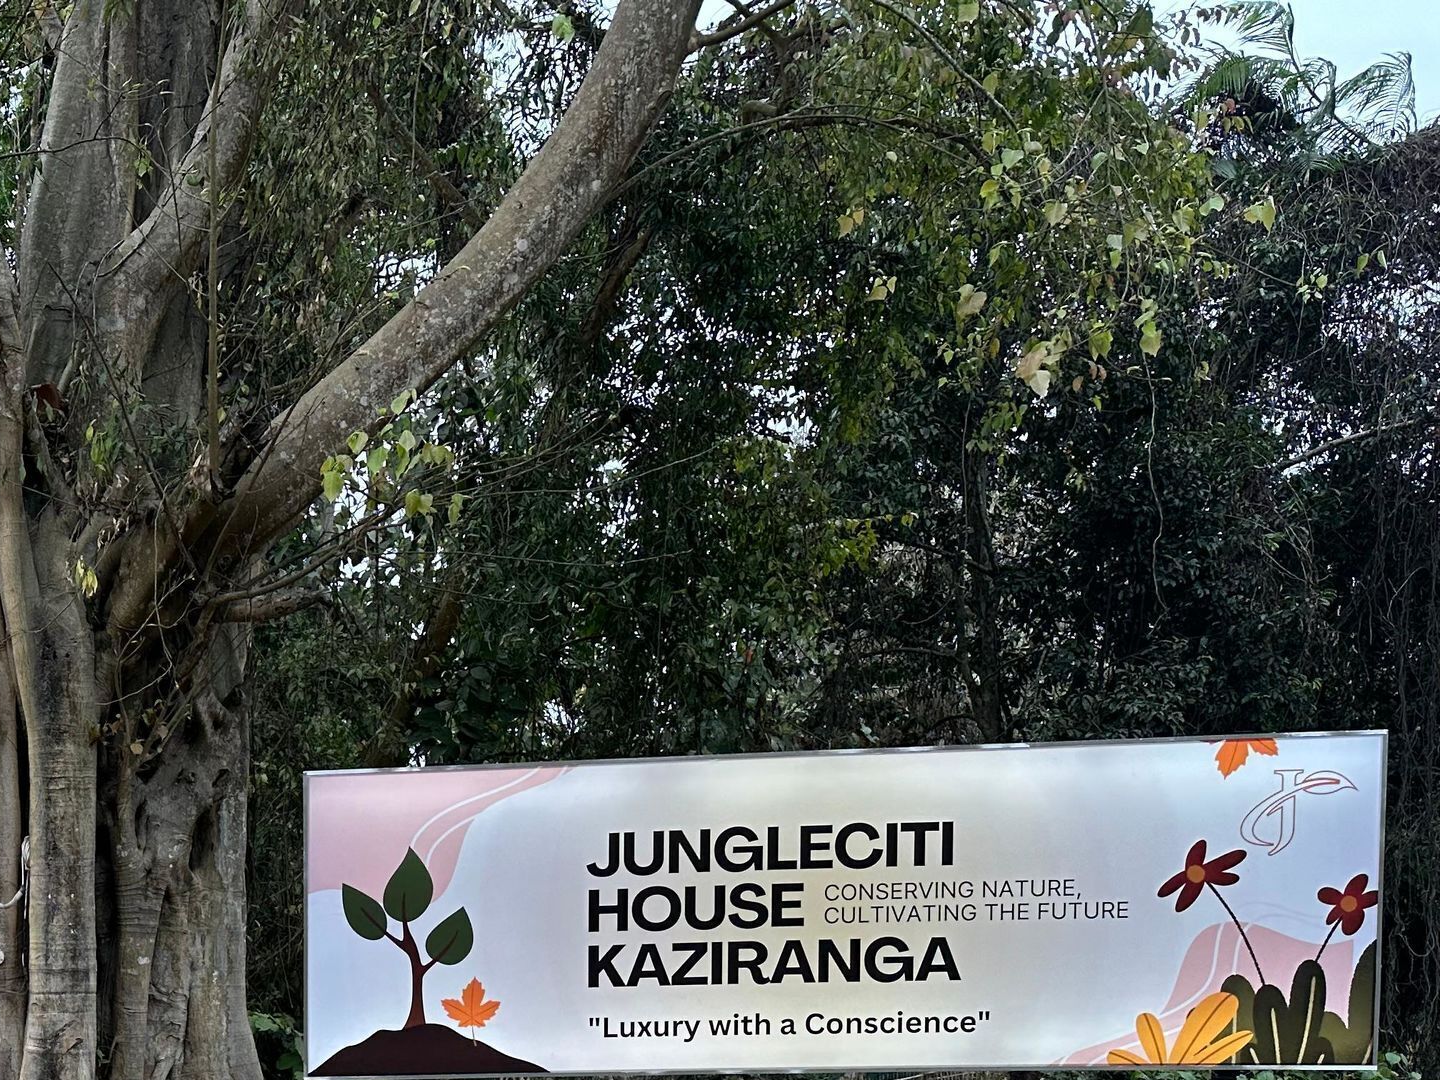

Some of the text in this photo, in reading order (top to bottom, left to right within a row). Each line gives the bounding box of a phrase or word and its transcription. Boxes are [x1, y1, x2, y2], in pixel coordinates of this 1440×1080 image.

[587, 821, 953, 877] JUNGLECITI
[589, 883, 804, 932] HOUSE
[825, 879, 1080, 901] CONSERVING NATURE,
[825, 902, 1128, 924] CULTIVATING THE FUTURE
[588, 937, 961, 988] KAZIRANGA
[590, 1011, 989, 1042] "Luxury with a Conscience"
